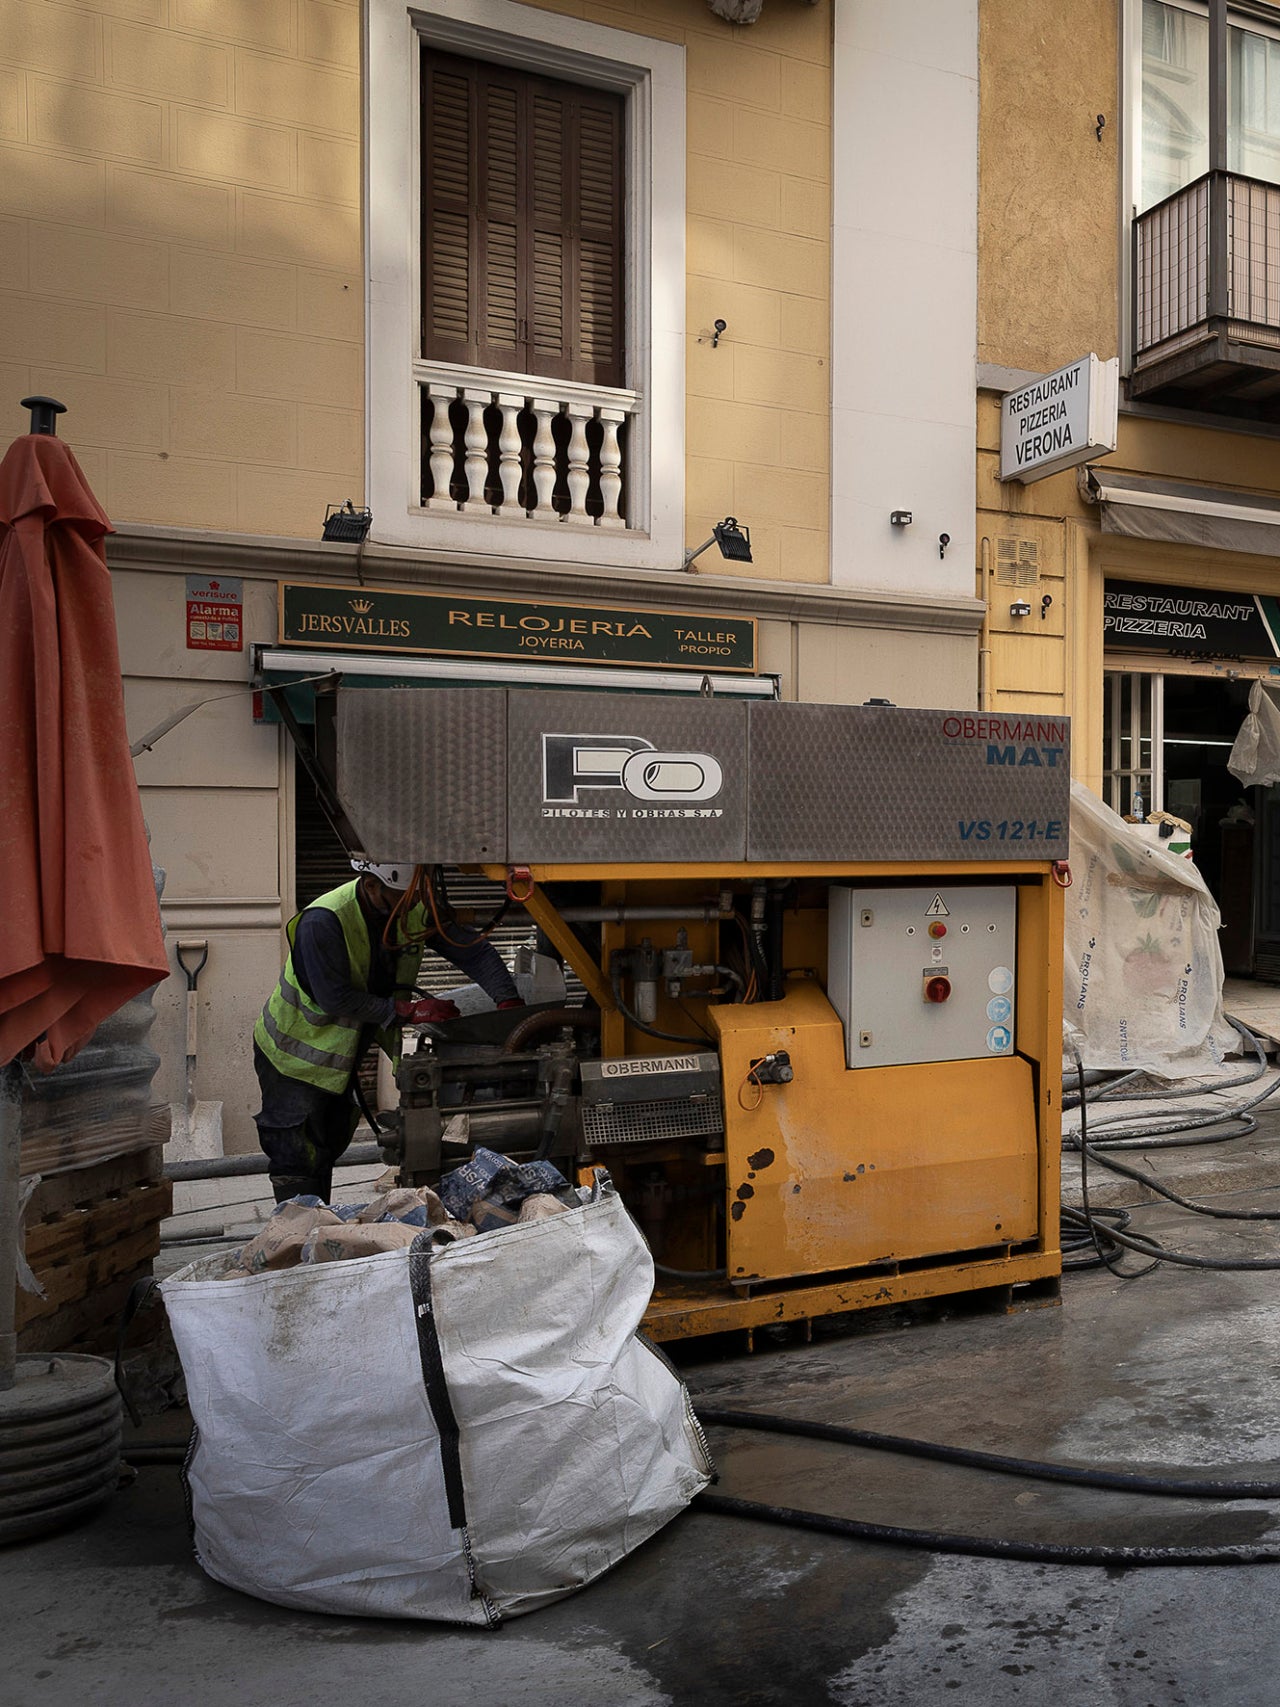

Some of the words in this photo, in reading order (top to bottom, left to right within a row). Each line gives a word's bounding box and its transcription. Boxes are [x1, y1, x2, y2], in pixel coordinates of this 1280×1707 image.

[1009, 367, 1080, 416] RESTAURANT
[1020, 400, 1067, 436] PIZZERIA
[1016, 424, 1072, 465] VERONA
[192, 590, 238, 600] verisure
[1104, 592, 1254, 621] RESTAURANT
[190, 604, 238, 616] Alarma
[298, 614, 410, 638] JERSVALLES
[448, 610, 652, 638] RELOJERIA
[1104, 616, 1206, 639] PIZZERIA
[519, 636, 584, 650] JOYERIA
[674, 630, 736, 644] TALLER
[680, 644, 731, 656] PROPIO
[943, 717, 1064, 742] OBERMANN
[986, 745, 1064, 768] MAT
[542, 809, 610, 818] PILOTES
[617, 809, 627, 818] Y
[634, 809, 687, 818] OBRAS
[1077, 952, 1092, 1010] PROLIANS
[1179, 980, 1189, 1029] PROLIANS
[606, 1058, 695, 1075] OBERMANN
